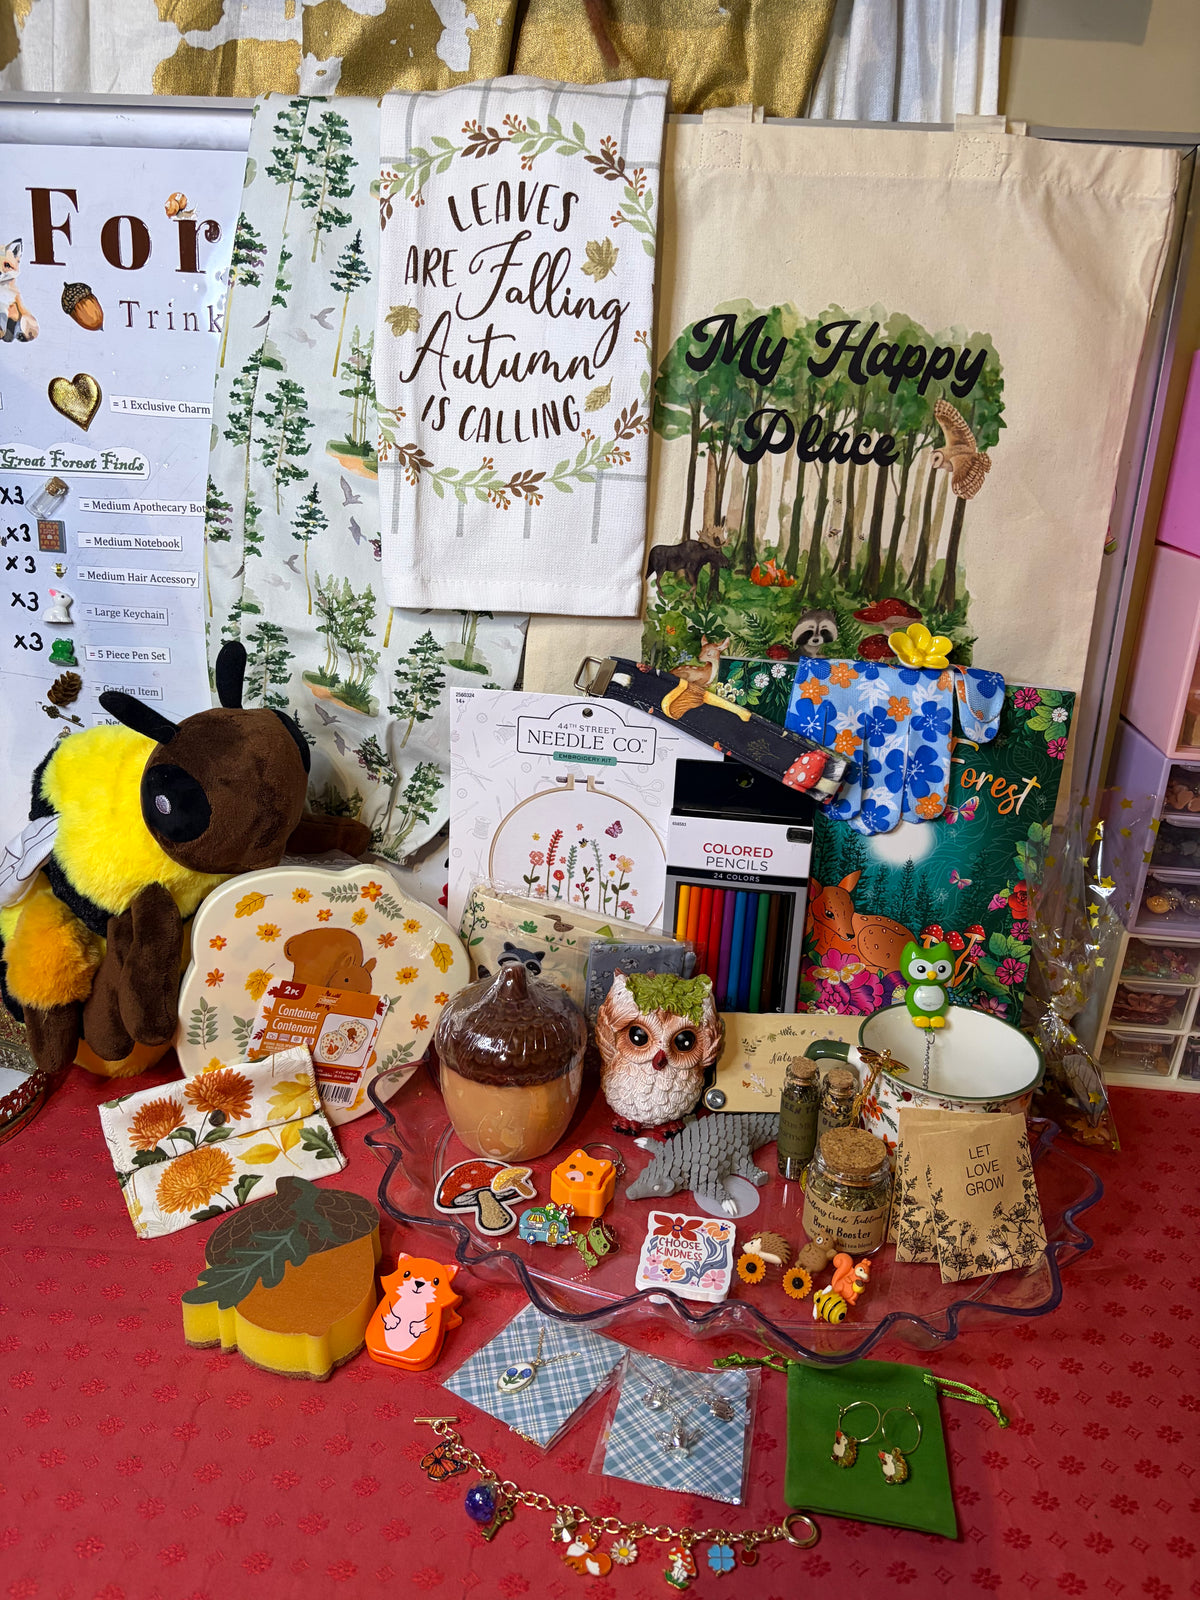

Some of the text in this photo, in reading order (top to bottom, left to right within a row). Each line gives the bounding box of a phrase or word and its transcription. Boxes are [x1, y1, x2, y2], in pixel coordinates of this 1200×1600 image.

[448, 181, 579, 232] LEAVES
[25, 187, 222, 274] For
[405, 229, 630, 369] ARE Falling
[400, 310, 595, 391] Autumn
[685, 314, 988, 398] My Happy
[122, 400, 127, 409] 1
[130, 400, 175, 412] Exclusive
[178, 404, 210, 414] Charm
[421, 395, 580, 444] IS CALLING
[737, 409, 899, 466] Place
[0, 449, 144, 471] Great Forest Finds
[92, 501, 131, 511] Medium
[133, 502, 187, 513] Apothecary
[94, 537, 132, 548] Medium
[135, 539, 180, 549] Notebook
[87, 571, 125, 582] Medium
[128, 573, 148, 583] Hair
[150, 574, 196, 586] Accessory
[95, 608, 121, 619] Large
[123, 609, 165, 620] Keychain
[98, 650, 104, 659] 5
[106, 650, 130, 661] Piece
[133, 651, 149, 661] Pen
[151, 652, 166, 661] Set
[138, 687, 159, 697] Item
[579, 725, 616, 734] STREET
[527, 730, 604, 751] NEEDLE
[558, 754, 599, 762] EMBROIDERY
[703, 843, 773, 858] COLORED
[706, 856, 769, 872] PENCILS
[726, 873, 761, 883] COLORS
[278, 1003, 321, 1021] Container
[272, 1018, 317, 1035] Contenant
[968, 1144, 991, 1160] LET
[964, 1160, 999, 1179] LOVE
[965, 1175, 1005, 1197] GROW
[836, 1226, 871, 1240] Booster
[659, 1237, 702, 1251] CHOOSE
[656, 1246, 702, 1262] KINDNESS
